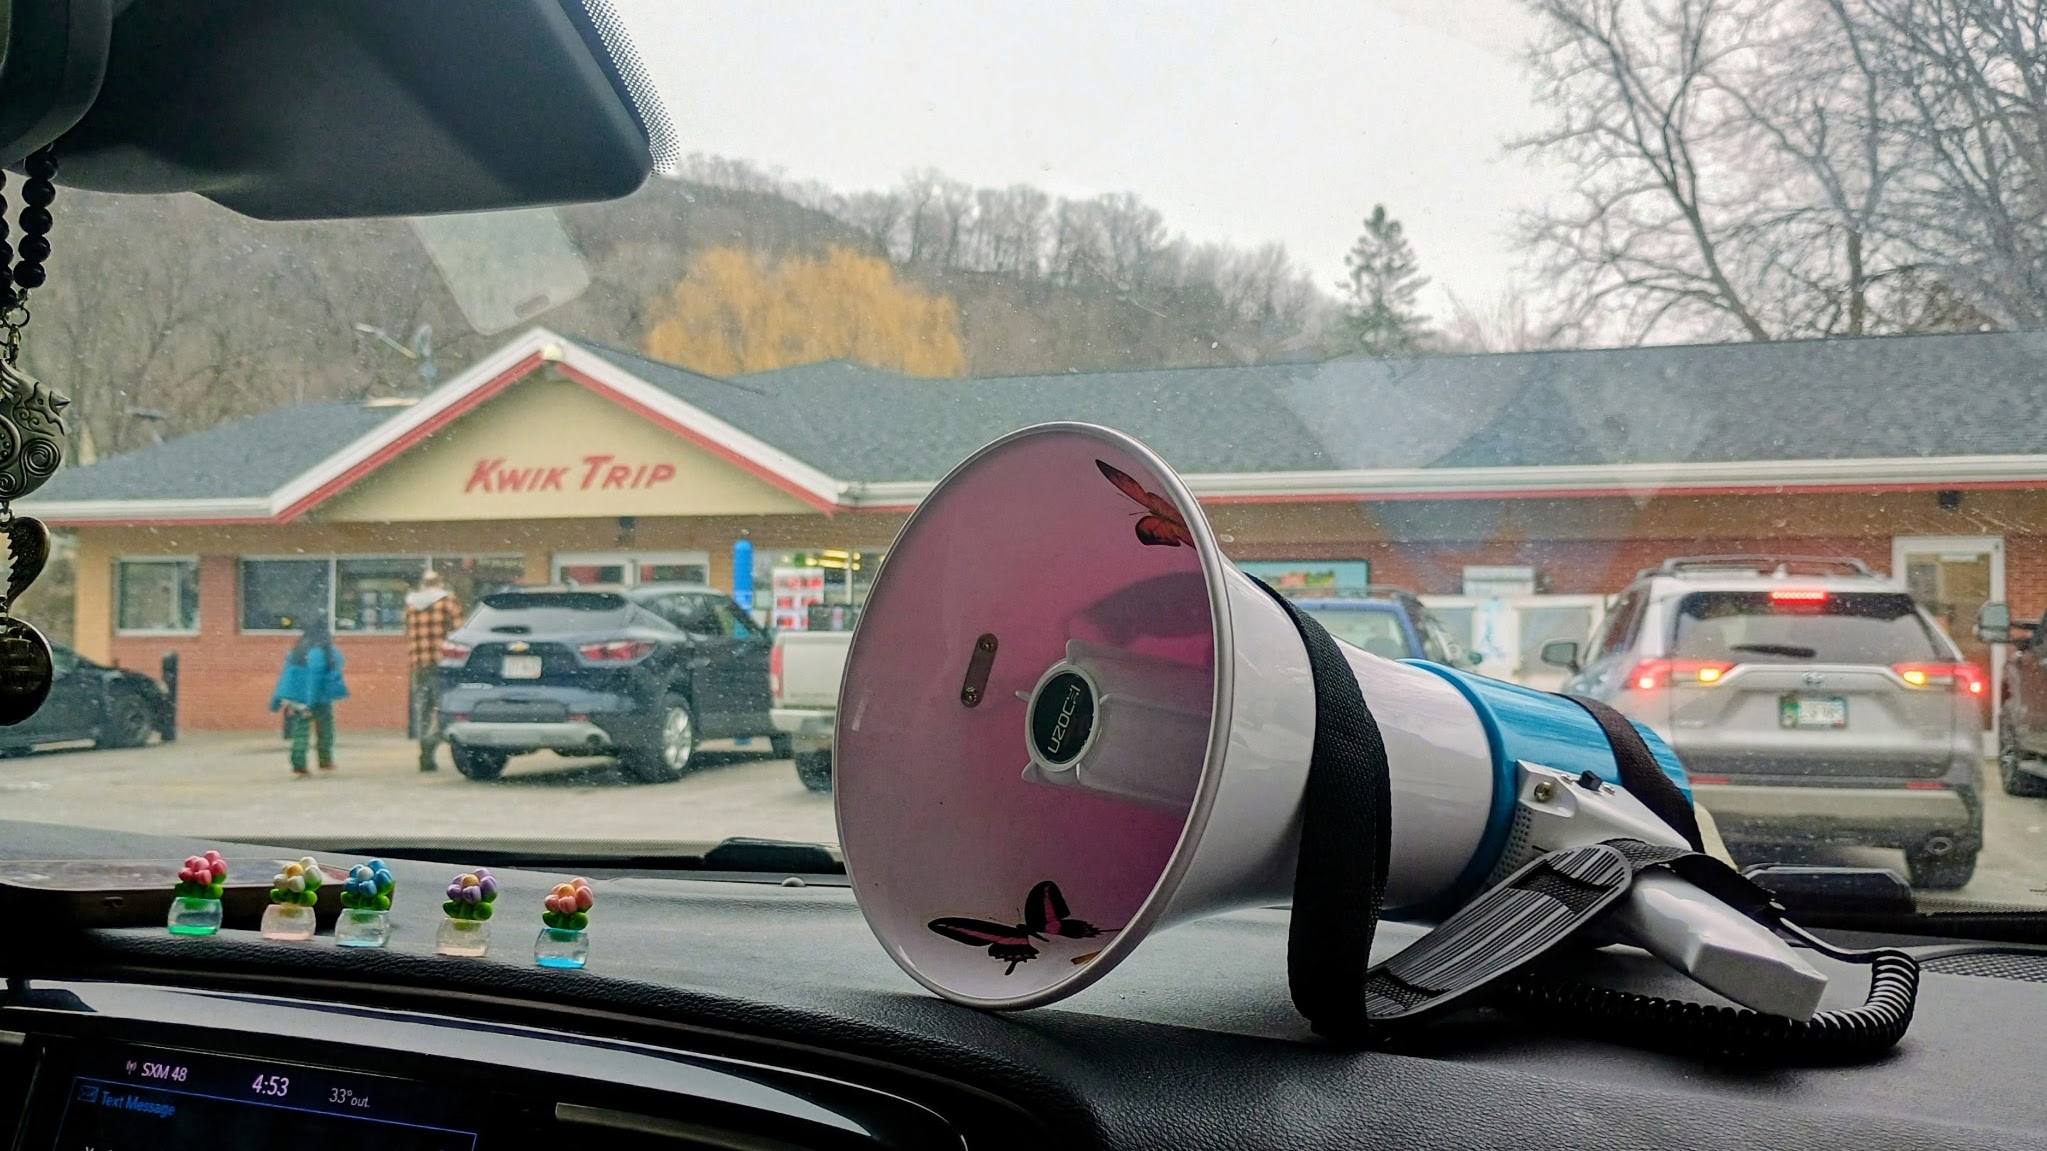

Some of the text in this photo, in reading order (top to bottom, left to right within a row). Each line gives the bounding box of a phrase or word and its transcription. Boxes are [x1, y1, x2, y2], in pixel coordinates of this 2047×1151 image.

[579, 454, 677, 491] TRIP
[141, 1062, 188, 1082] SXM 48
[252, 1074, 290, 1096] 4:53
[102, 1090, 176, 1118] Text Message
